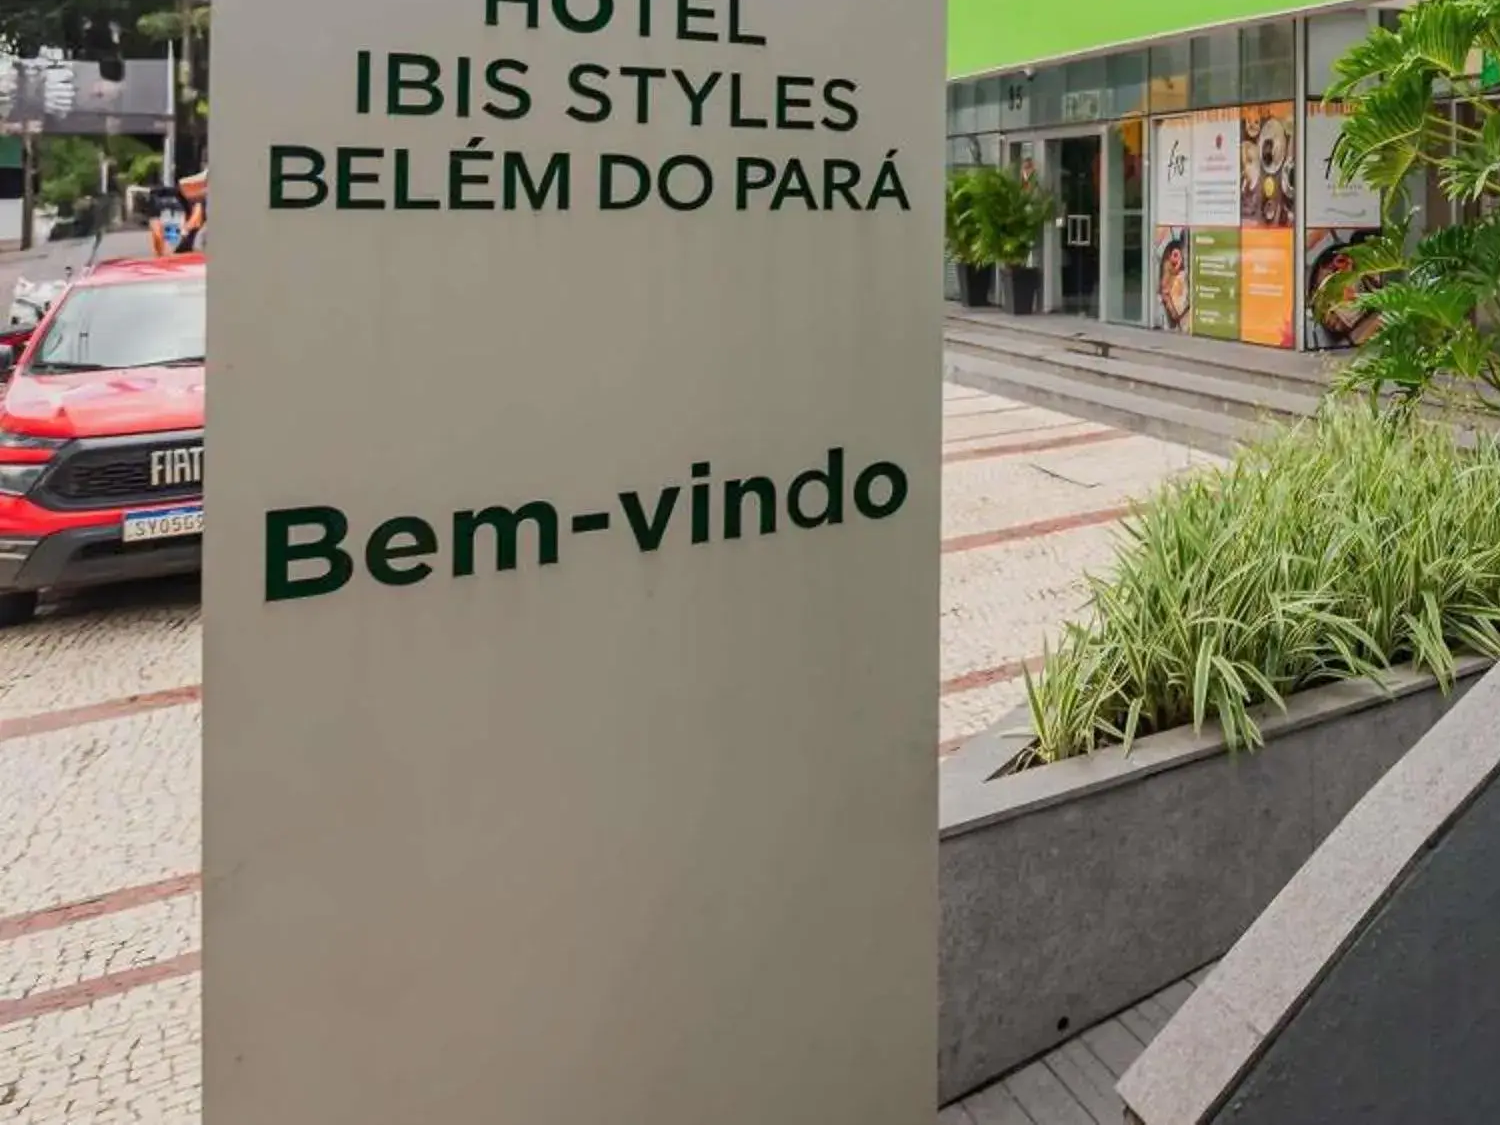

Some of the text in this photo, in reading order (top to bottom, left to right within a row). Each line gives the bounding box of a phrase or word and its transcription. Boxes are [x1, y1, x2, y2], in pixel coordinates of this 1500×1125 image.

[355, 50, 860, 133] IBIS STYLES
[268, 136, 912, 212] BELÉM DO PARÁ
[151, 446, 204, 487] FIAT
[264, 446, 910, 604] Bem-vindo
